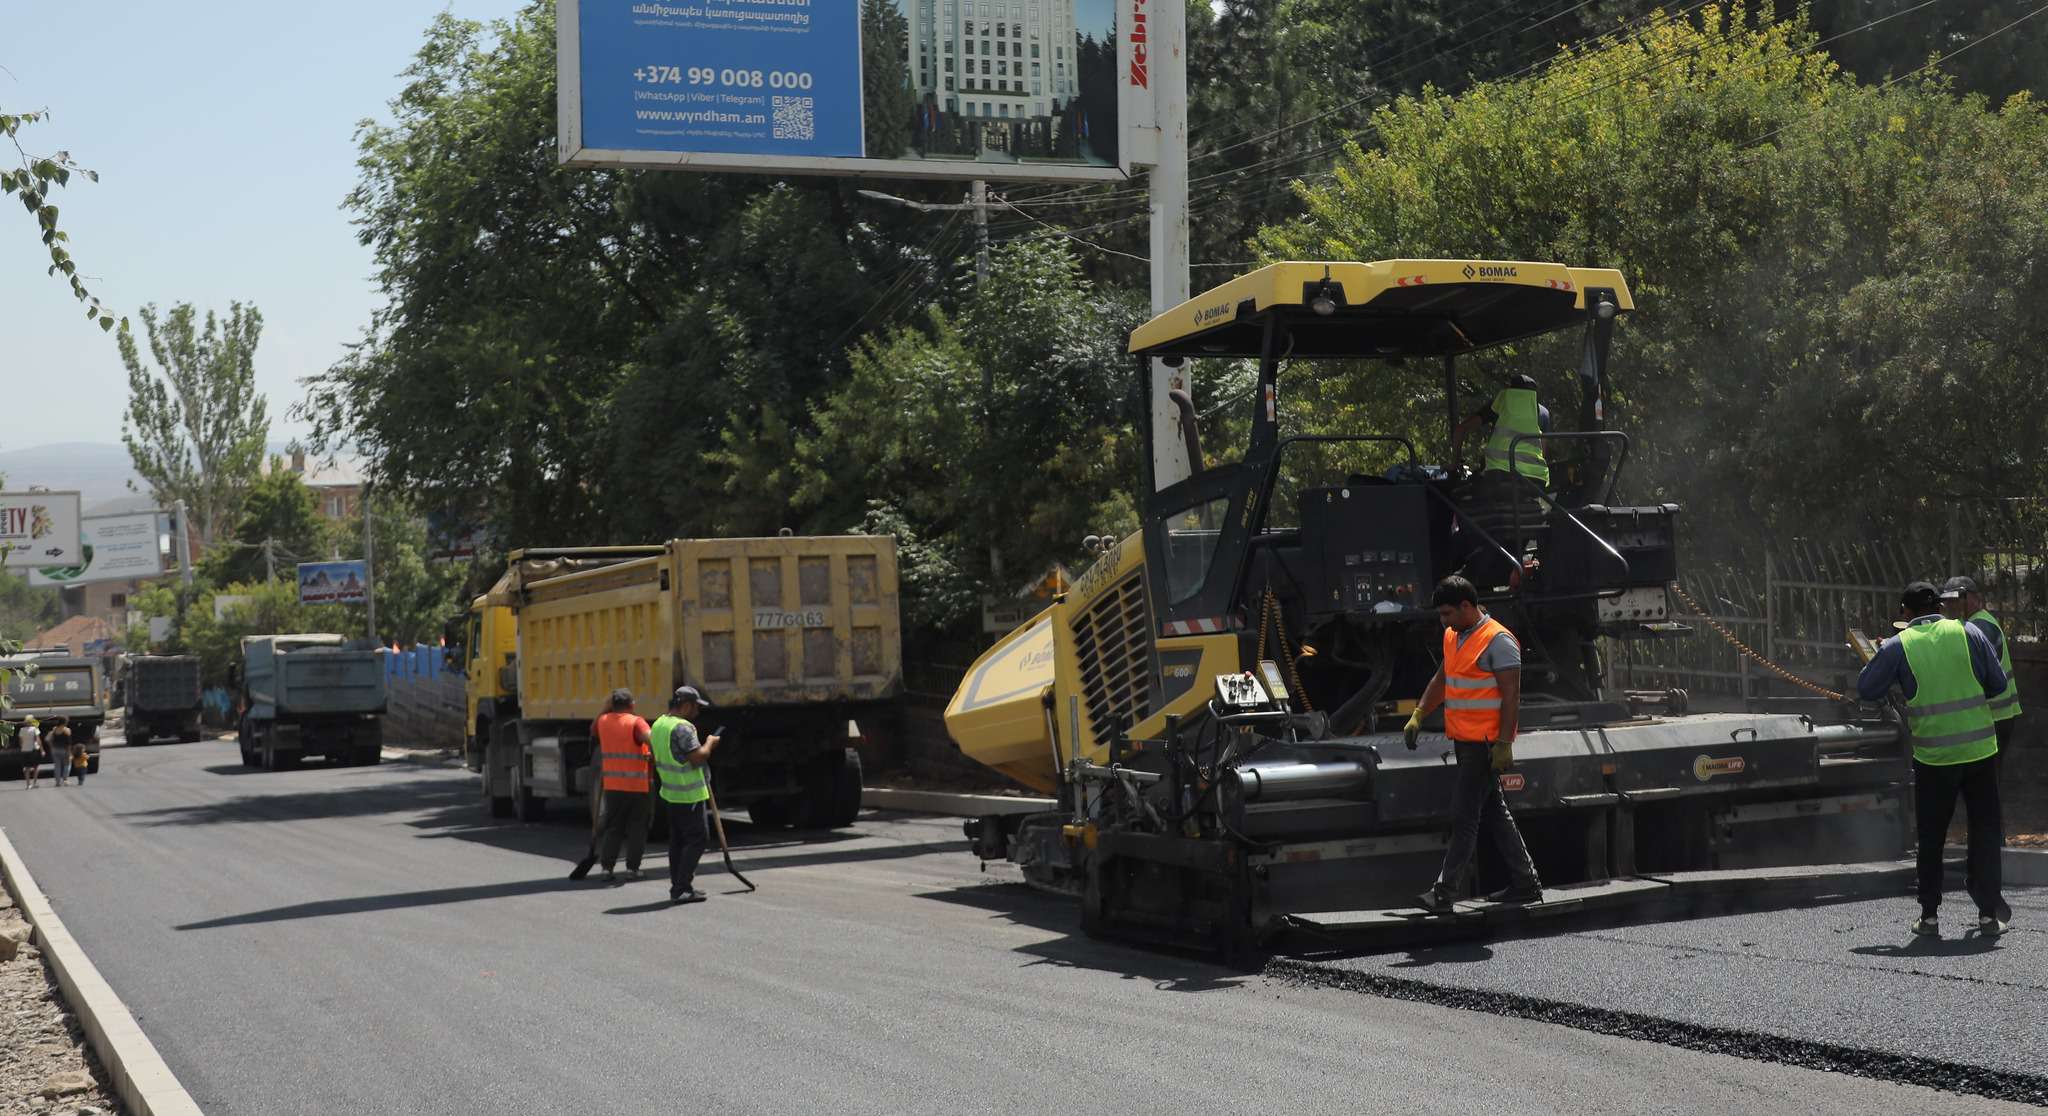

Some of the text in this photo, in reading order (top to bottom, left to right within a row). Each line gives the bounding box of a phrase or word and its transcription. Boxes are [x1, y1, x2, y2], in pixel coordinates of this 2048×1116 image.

[634, 66, 812, 89] +374 99 008 000
[636, 110, 765, 124] www.wyndham.am
[1479, 266, 1517, 277] BOMAG
[1204, 303, 1229, 320] BOMAG
